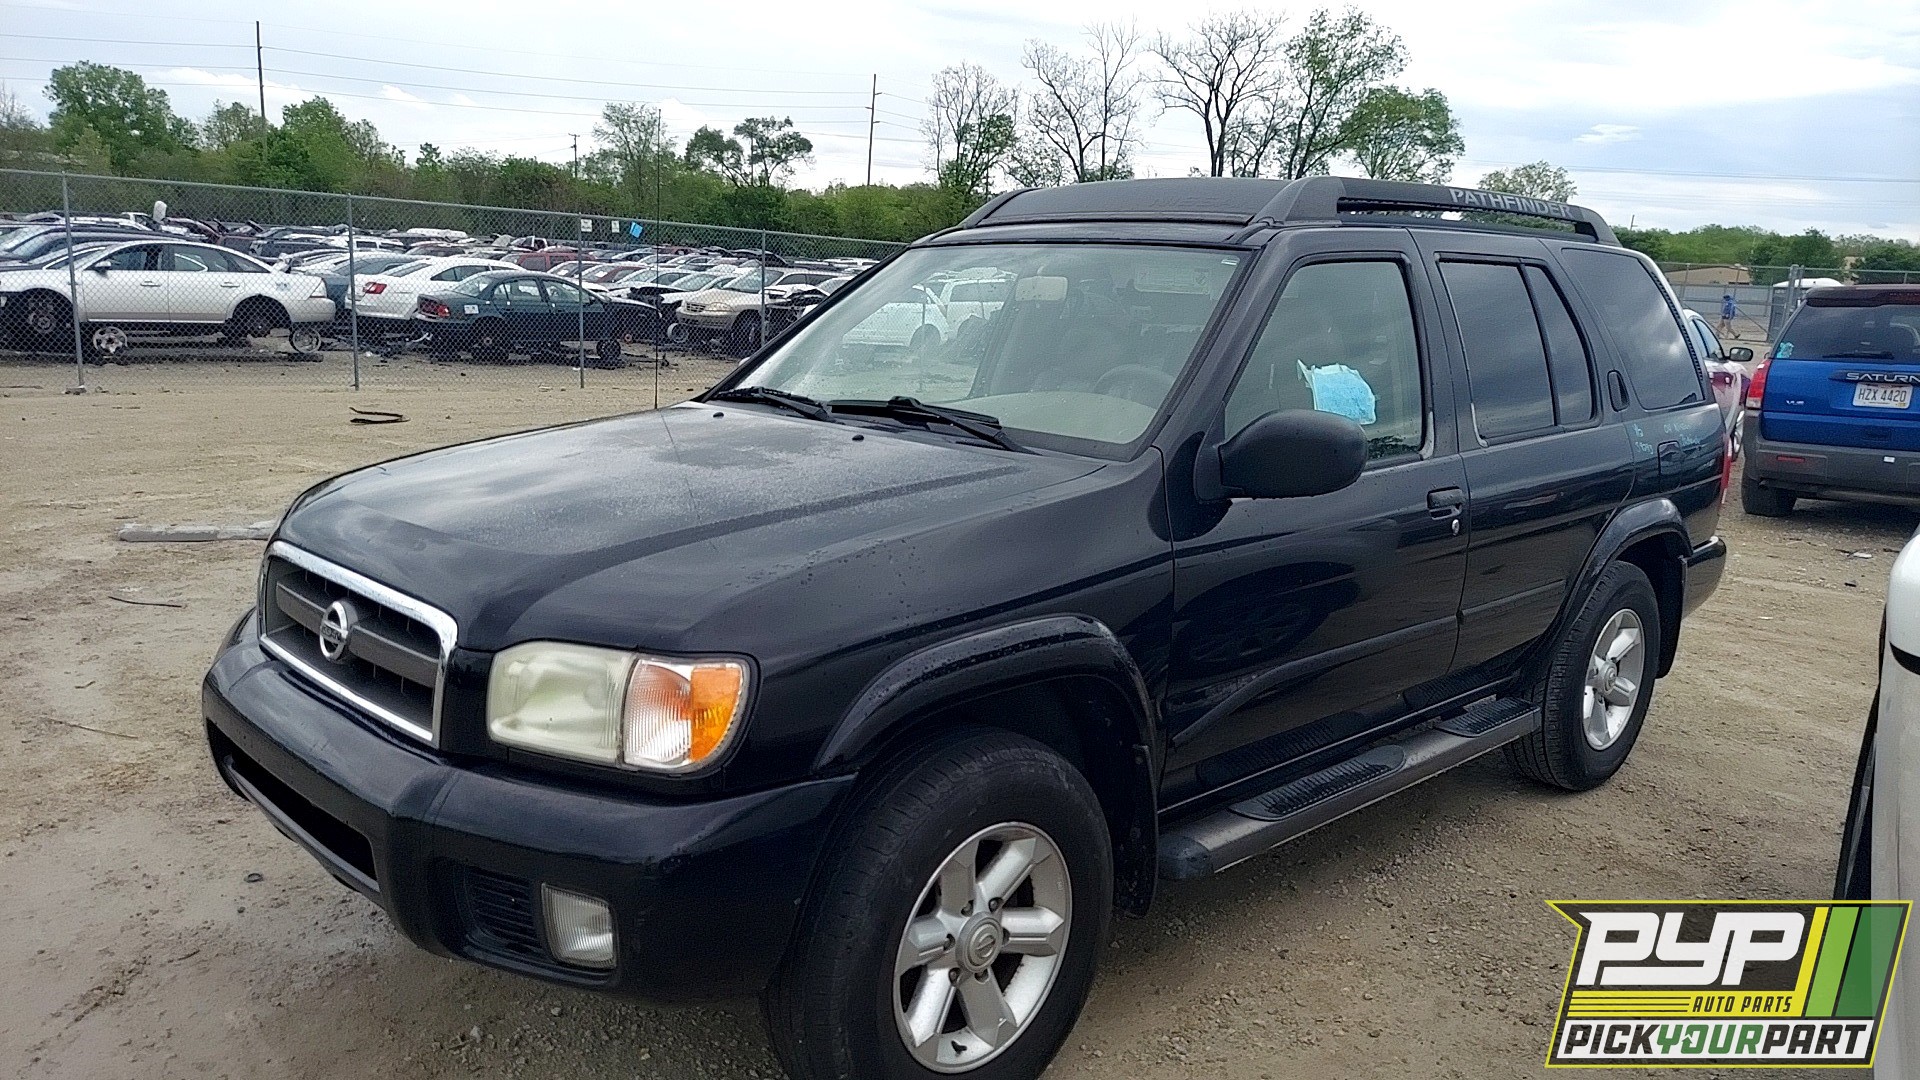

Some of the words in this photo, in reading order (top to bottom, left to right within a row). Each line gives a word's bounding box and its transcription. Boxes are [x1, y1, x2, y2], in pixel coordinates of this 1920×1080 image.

[1449, 188, 1574, 219] PATHFINDER
[1846, 372, 1920, 383] SATURN
[1858, 388, 1878, 401] HZX
[1880, 389, 1907, 403] 4420
